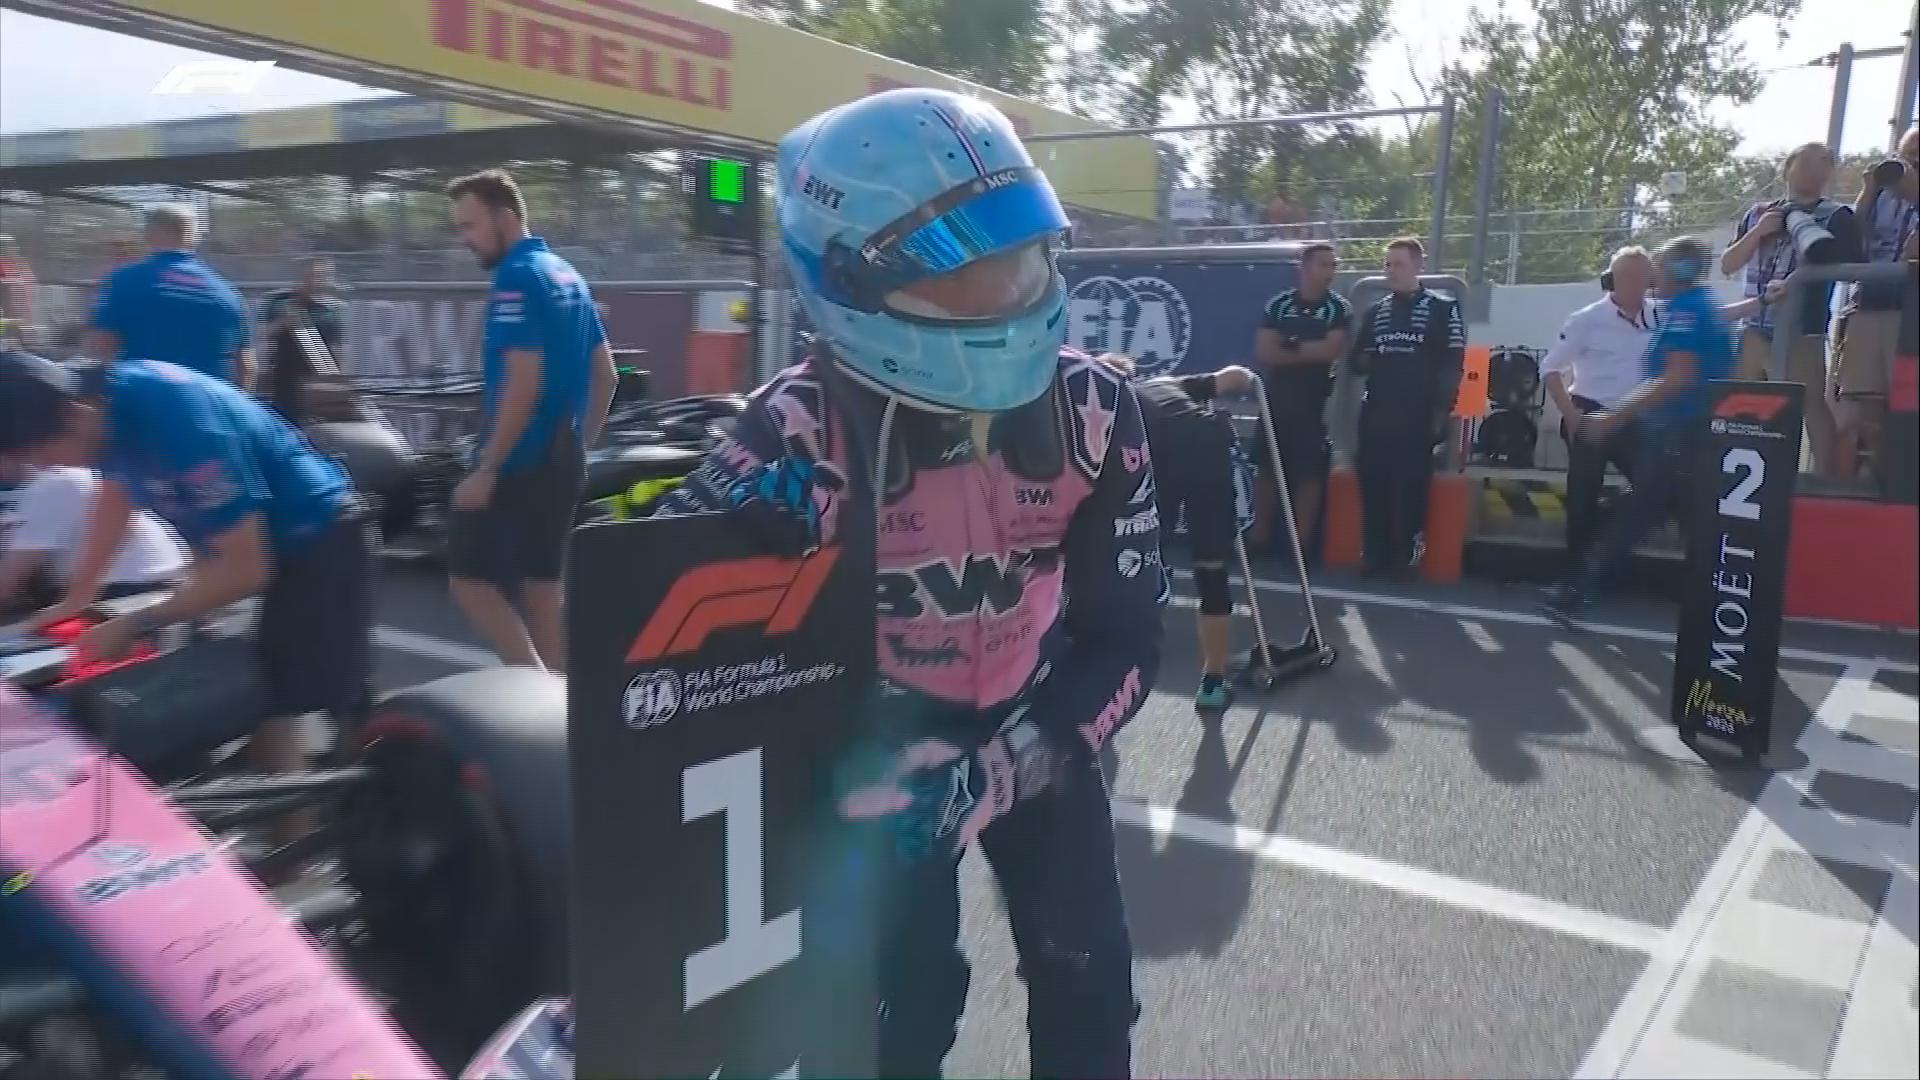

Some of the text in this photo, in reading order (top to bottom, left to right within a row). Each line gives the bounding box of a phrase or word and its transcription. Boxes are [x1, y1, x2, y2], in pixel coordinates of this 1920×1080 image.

[429, 0, 733, 111] PIRELLI
[802, 176, 844, 212] BWT
[986, 169, 1018, 189] MSC
[1718, 446, 1767, 520] 2
[1710, 535, 1758, 684] MOËT
[683, 654, 786, 695] FIA Formula 1
[683, 664, 834, 714] World Championship
[682, 747, 801, 1013] 1
